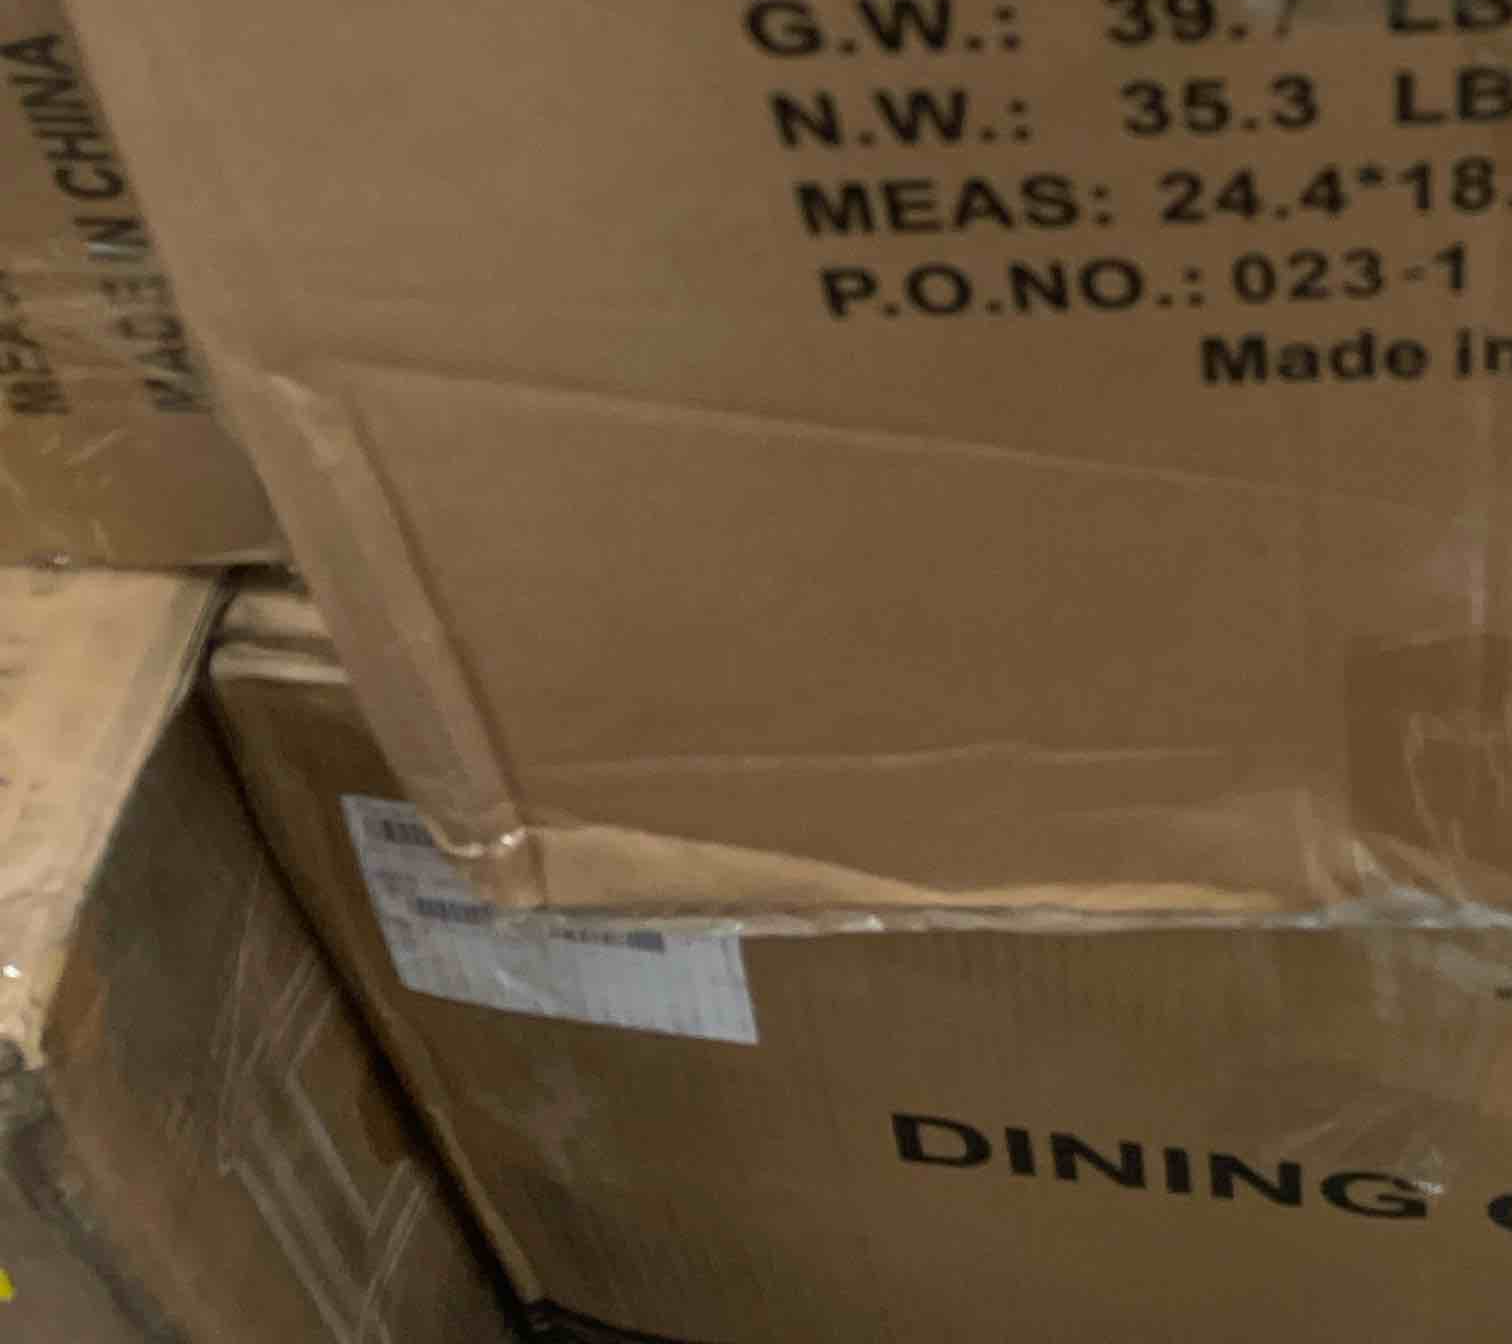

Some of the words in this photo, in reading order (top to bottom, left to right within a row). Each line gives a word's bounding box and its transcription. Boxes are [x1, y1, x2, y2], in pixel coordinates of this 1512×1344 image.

[0, 32, 127, 202] CHINA
[771, 88, 1030, 149] N.W.:
[1120, 72, 1321, 138] 35.3
[75, 215, 152, 262] IN
[795, 172, 1113, 237] MEAS:
[1200, 329, 1430, 386] Made
[891, 1113, 1428, 1219] DINING
